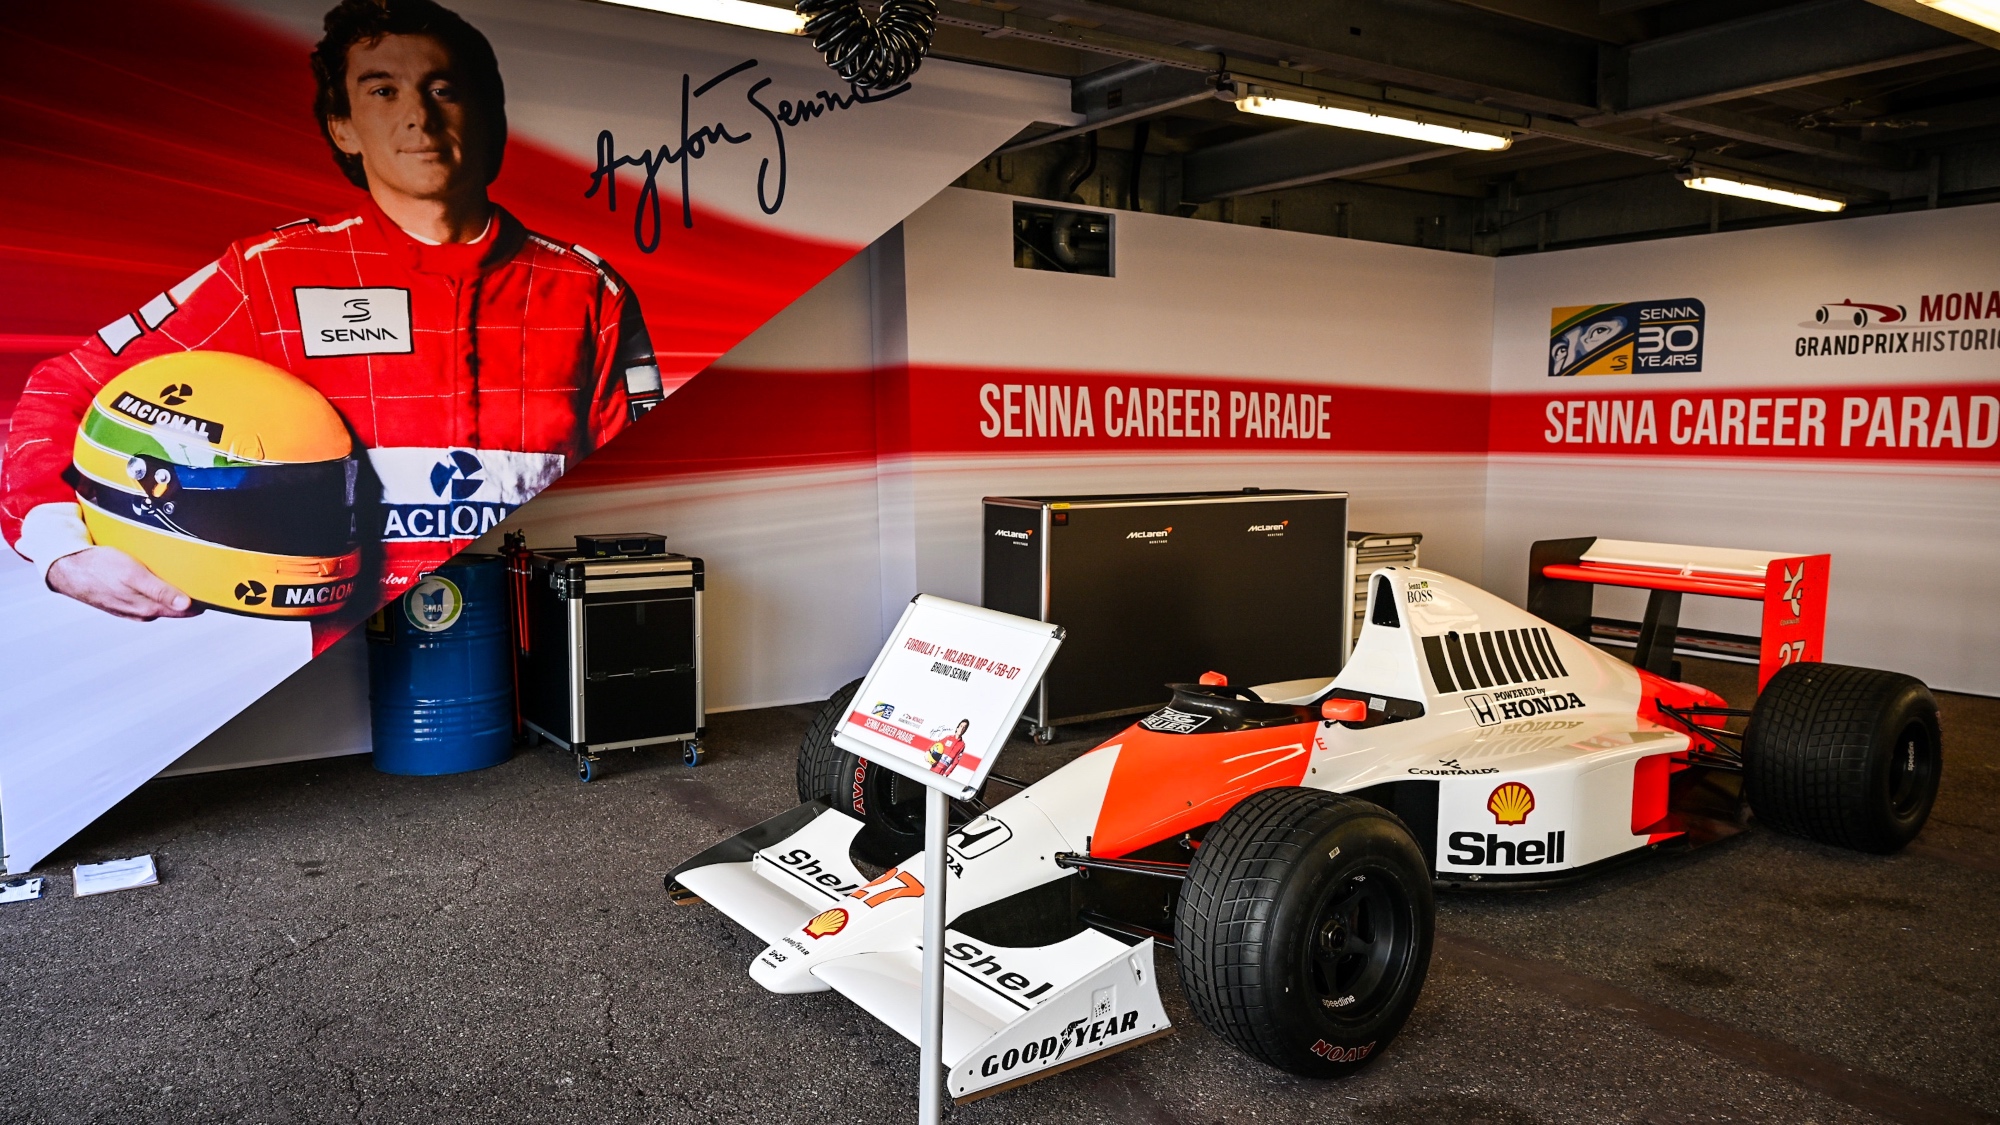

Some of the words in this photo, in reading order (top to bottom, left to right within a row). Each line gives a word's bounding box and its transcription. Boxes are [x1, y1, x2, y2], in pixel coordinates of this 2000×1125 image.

[585, 59, 757, 253] Ayrton
[1639, 306, 1699, 320] SENNA
[320, 328, 398, 342] SENNA
[1638, 324, 1699, 354] 30
[1911, 328, 2000, 353] HISTORI
[1638, 354, 1697, 367] YEARS
[117, 395, 210, 437] NACIONAL
[979, 383, 1095, 438] SENNA
[1104, 386, 1220, 437] CAREER
[1229, 390, 1332, 439] PARADE
[1544, 400, 1658, 444] SENNA
[1669, 397, 1827, 447] CAREER
[995, 529, 1029, 539] McLaren
[1126, 530, 1168, 539] McLaren
[1247, 524, 1284, 532] McLaren
[1407, 590, 1433, 603] BOSS
[423, 604, 443, 613] SMA
[904, 637, 935, 656] FORMULA
[934, 646, 941, 657] 1
[942, 648, 977, 668] MCLAREN
[973, 657, 989, 671] MP
[986, 661, 1021, 680] 4/5B-07
[1779, 640, 1805, 668] 27
[930, 661, 952, 677] BRUNO
[949, 667, 971, 682] SENNA
[1493, 687, 1536, 702] POWERED
[1535, 686, 1546, 696] by
[1499, 692, 1586, 720] HONDA
[864, 718, 880, 731] SENNA
[878, 722, 898, 737] CAREER
[895, 728, 915, 744] PARADE
[1148, 715, 1194, 732] HEUER
[1315, 738, 1328, 751] E
[1407, 768, 1500, 776] COURTAULDS
[1447, 830, 1565, 866] Shell
[778, 849, 860, 897] Shel
[944, 942, 1053, 1004] Shel
[1322, 994, 1355, 1008] speedline
[1310, 1039, 1376, 1062] AVON
